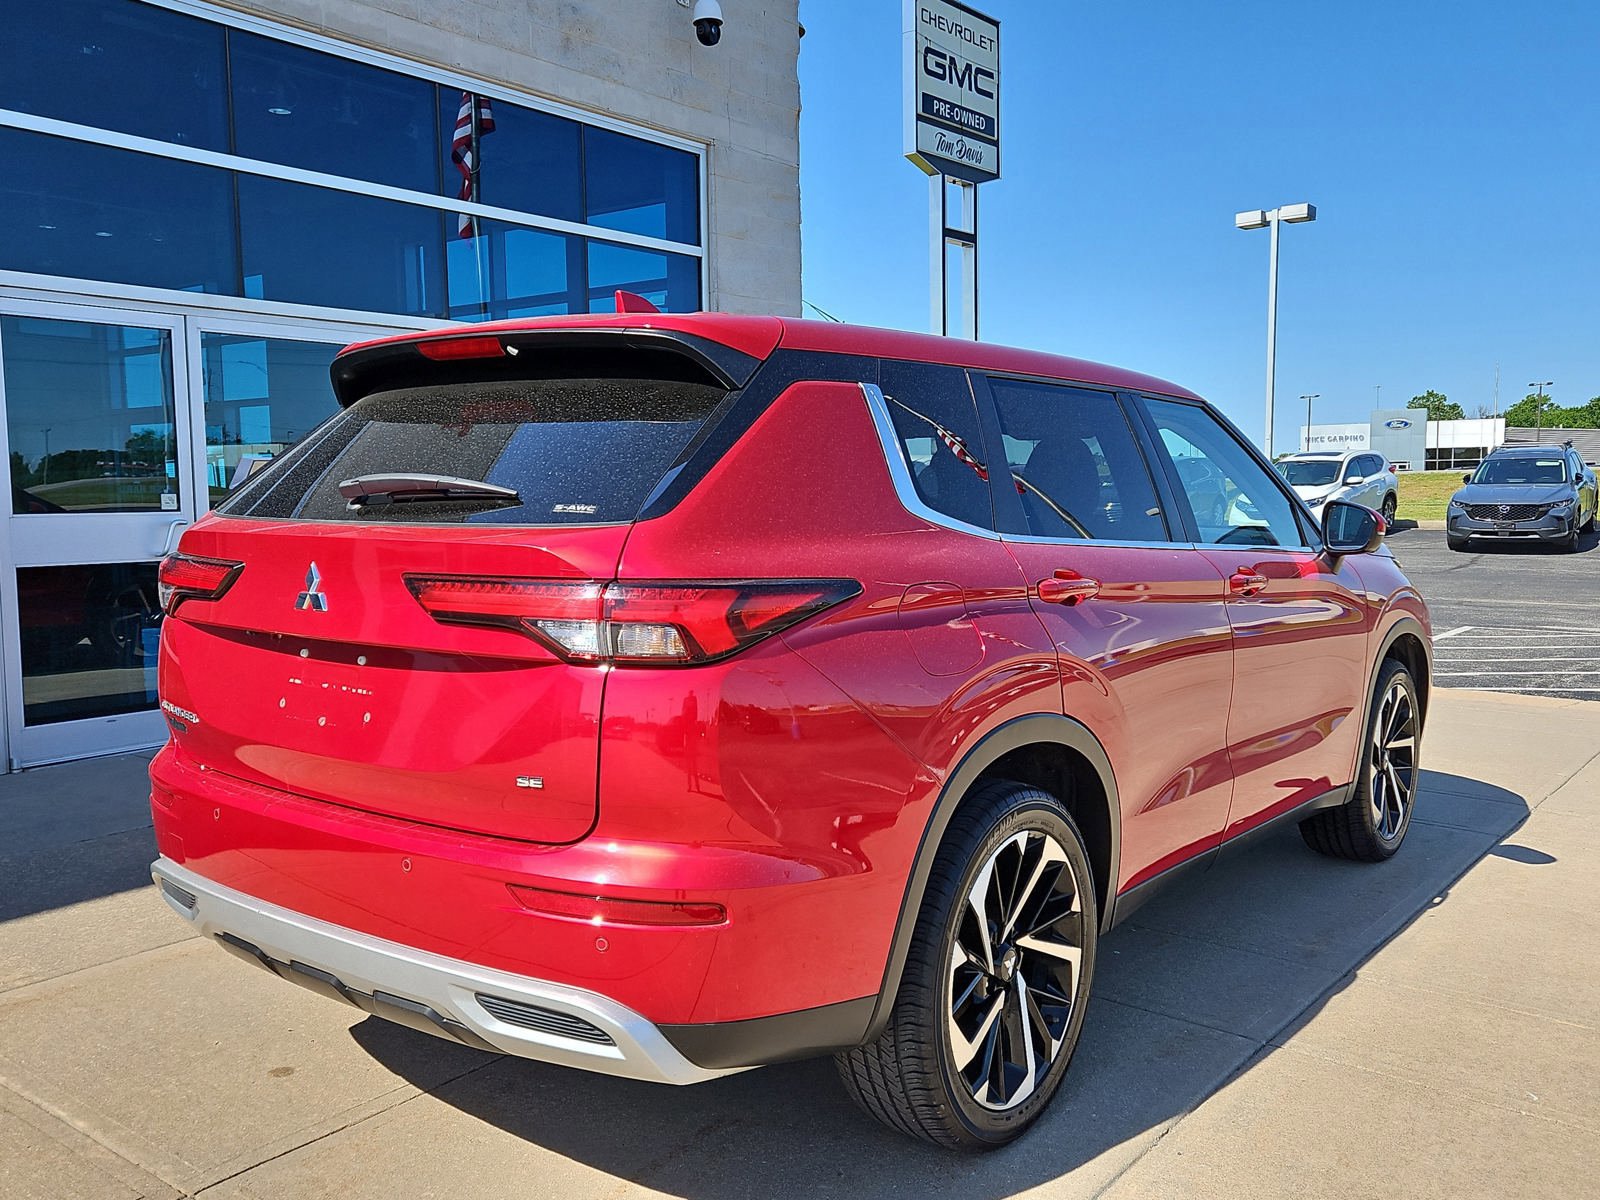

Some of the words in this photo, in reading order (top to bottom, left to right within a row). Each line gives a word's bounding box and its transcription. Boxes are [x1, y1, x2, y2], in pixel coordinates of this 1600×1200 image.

[921, 7, 995, 52] CHEVROLET
[923, 46, 994, 100] GMC
[933, 99, 986, 130] PRE-OWNED
[935, 131, 955, 156] Tom
[956, 138, 984, 165] Davis
[516, 775, 544, 788] SE
